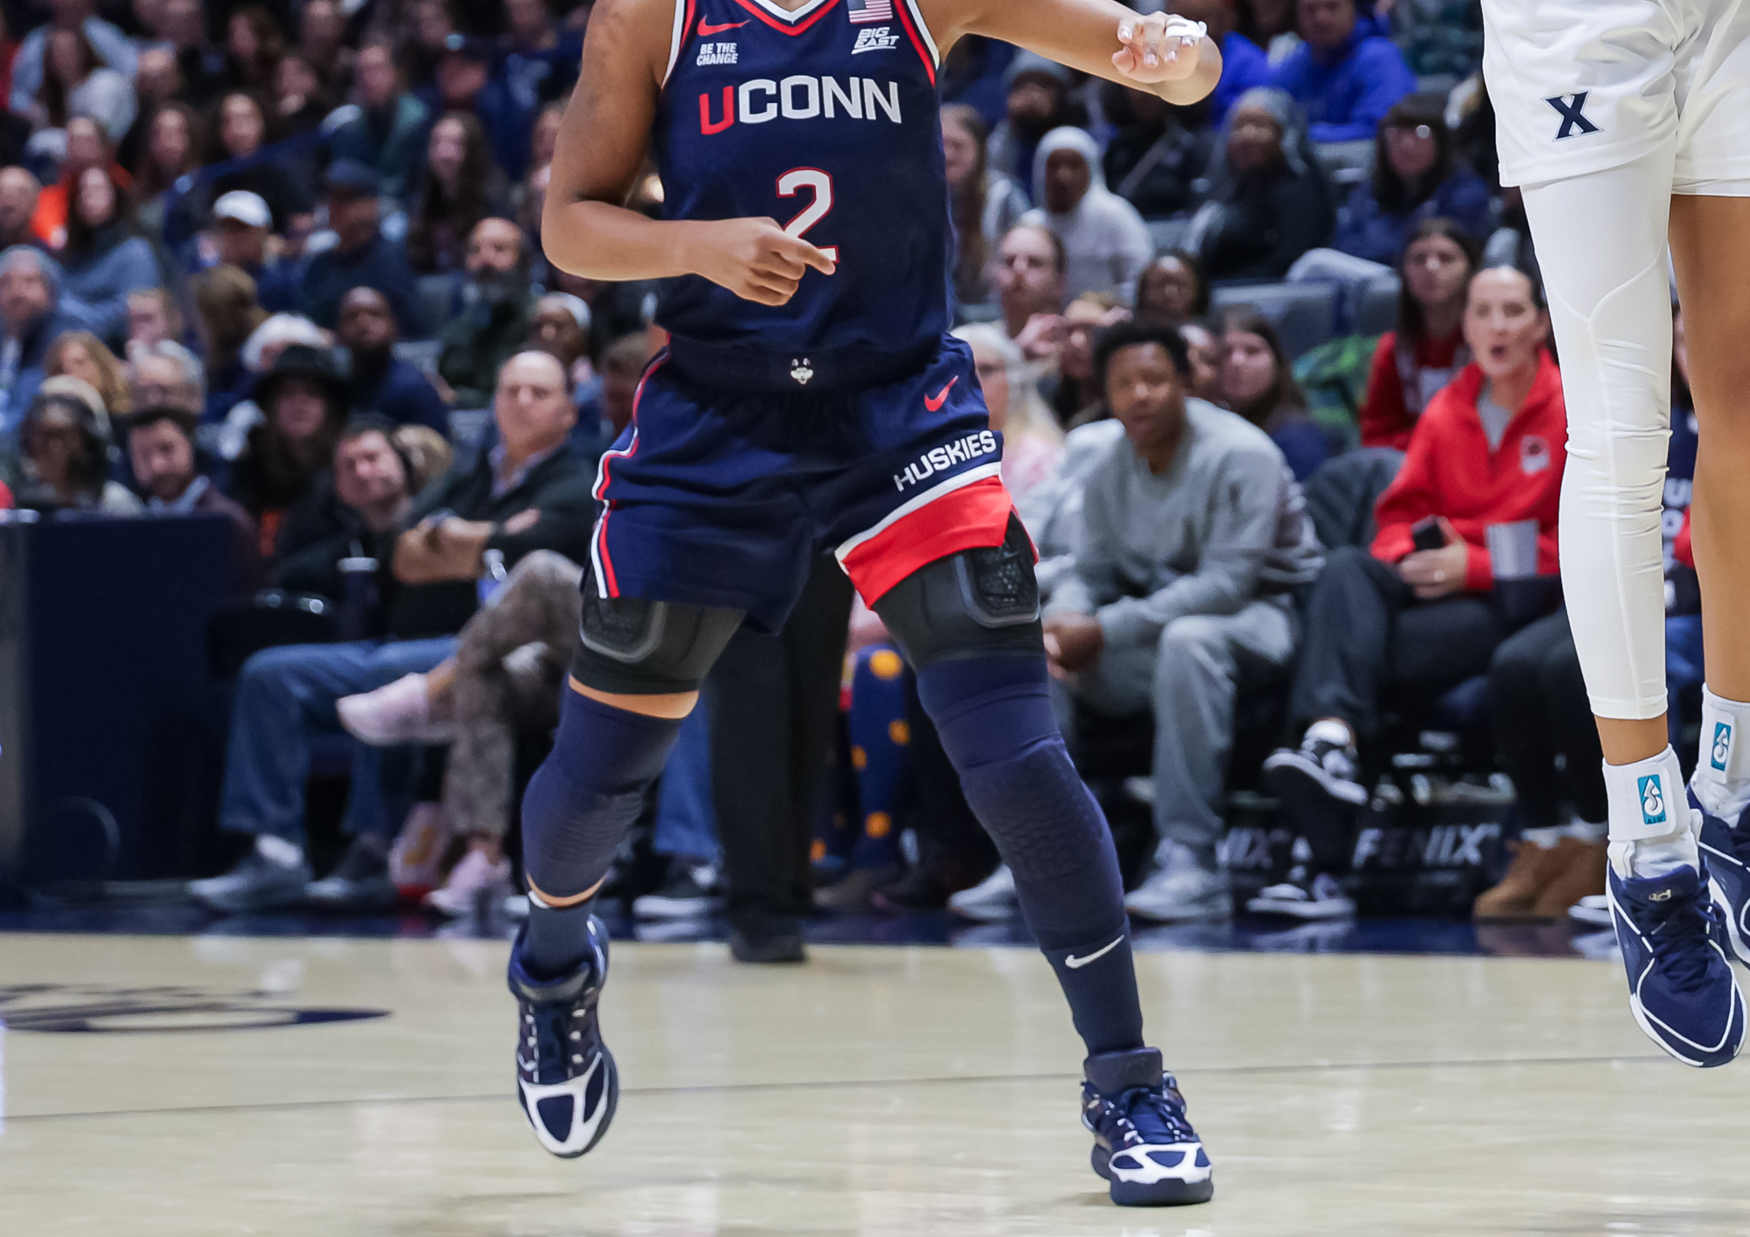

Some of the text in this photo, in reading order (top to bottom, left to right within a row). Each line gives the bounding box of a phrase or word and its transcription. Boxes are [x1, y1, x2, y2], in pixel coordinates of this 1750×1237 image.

[701, 43, 737, 54] BE THE
[854, 36, 899, 48] EAST
[858, 27, 890, 39] BIG
[696, 54, 738, 66] CHANGE
[699, 75, 902, 135] UCONN
[1541, 90, 1605, 142] X
[775, 167, 840, 264] 2
[893, 430, 998, 491] HUSKIES
